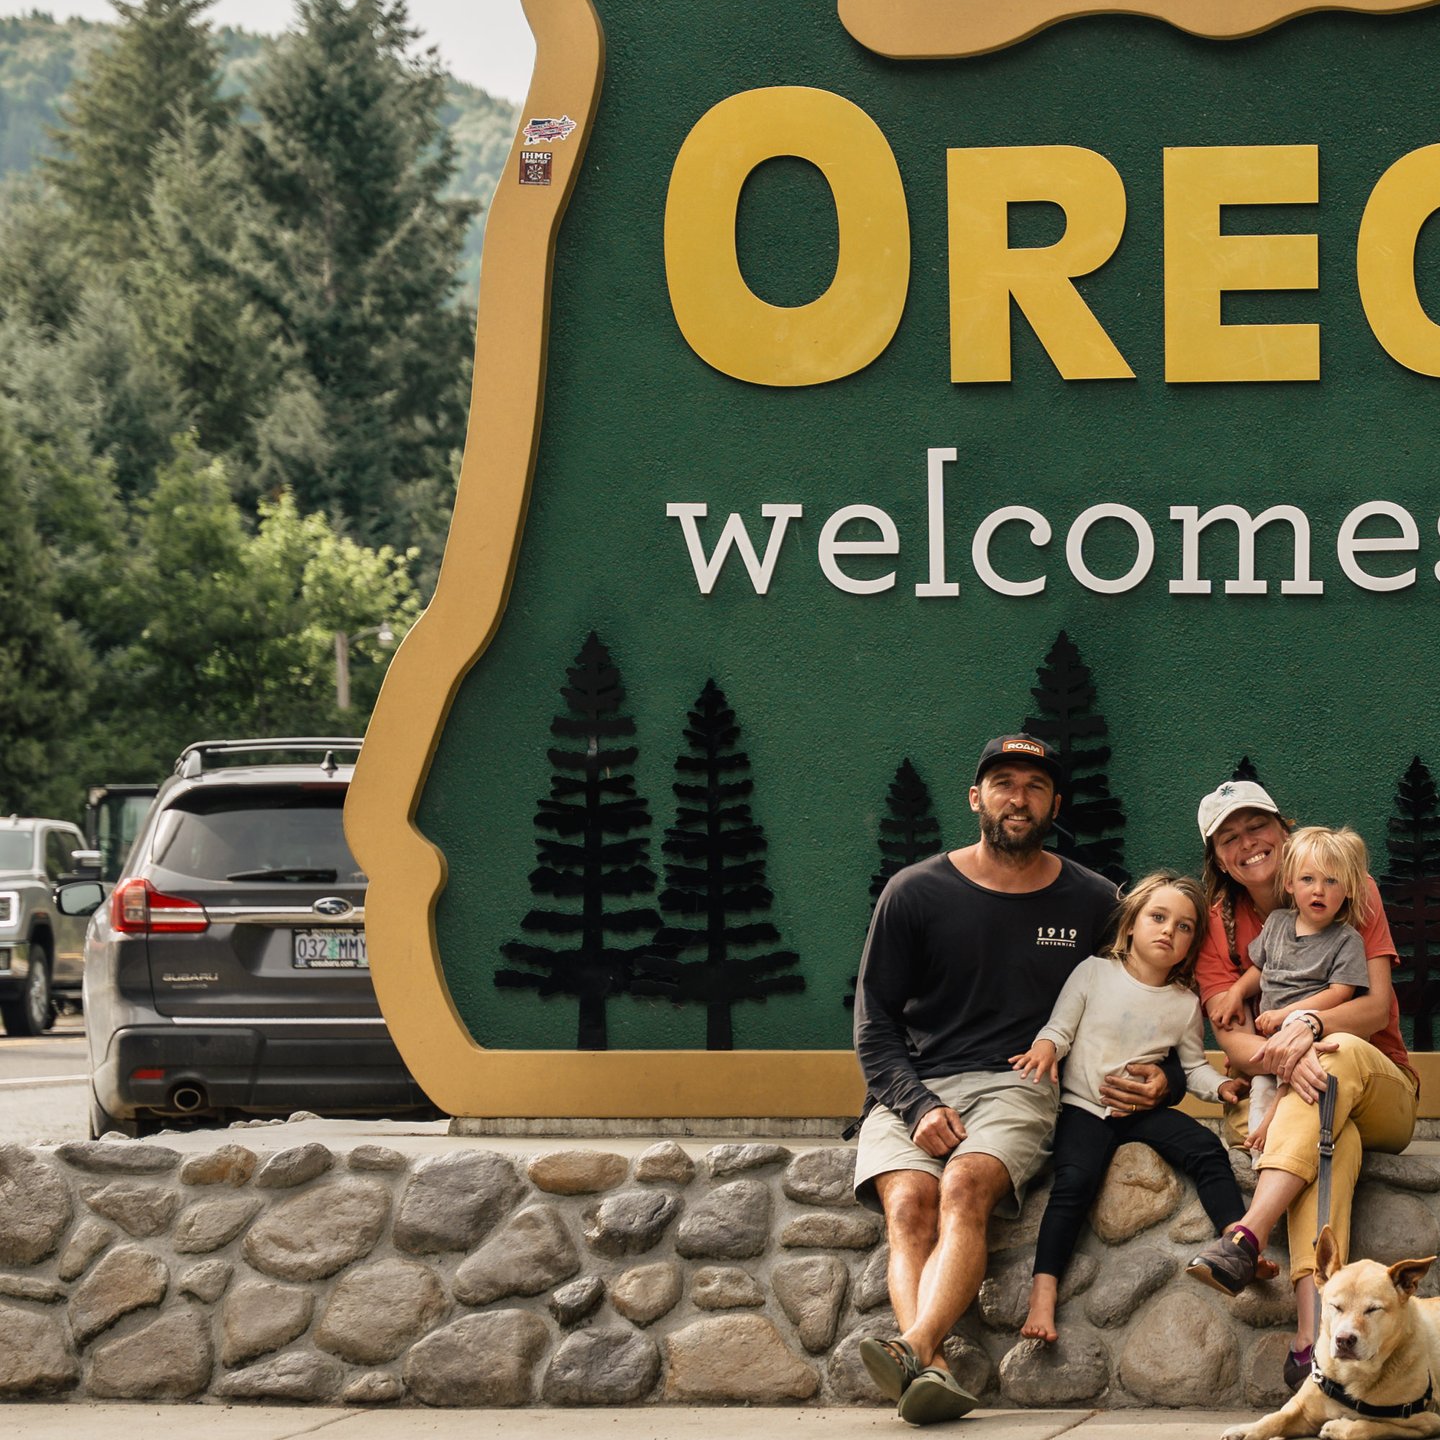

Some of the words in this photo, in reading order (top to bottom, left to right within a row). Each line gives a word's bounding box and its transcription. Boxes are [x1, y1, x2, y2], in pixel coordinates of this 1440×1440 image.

[522, 152, 552, 160] IHMC
[1007, 743, 1040, 753] ROAM
[1037, 927, 1077, 940] 1919
[298, 938, 328, 959] 032
[1036, 940, 1076, 948] CENTENNIAL
[162, 972, 219, 982] SUBARU
